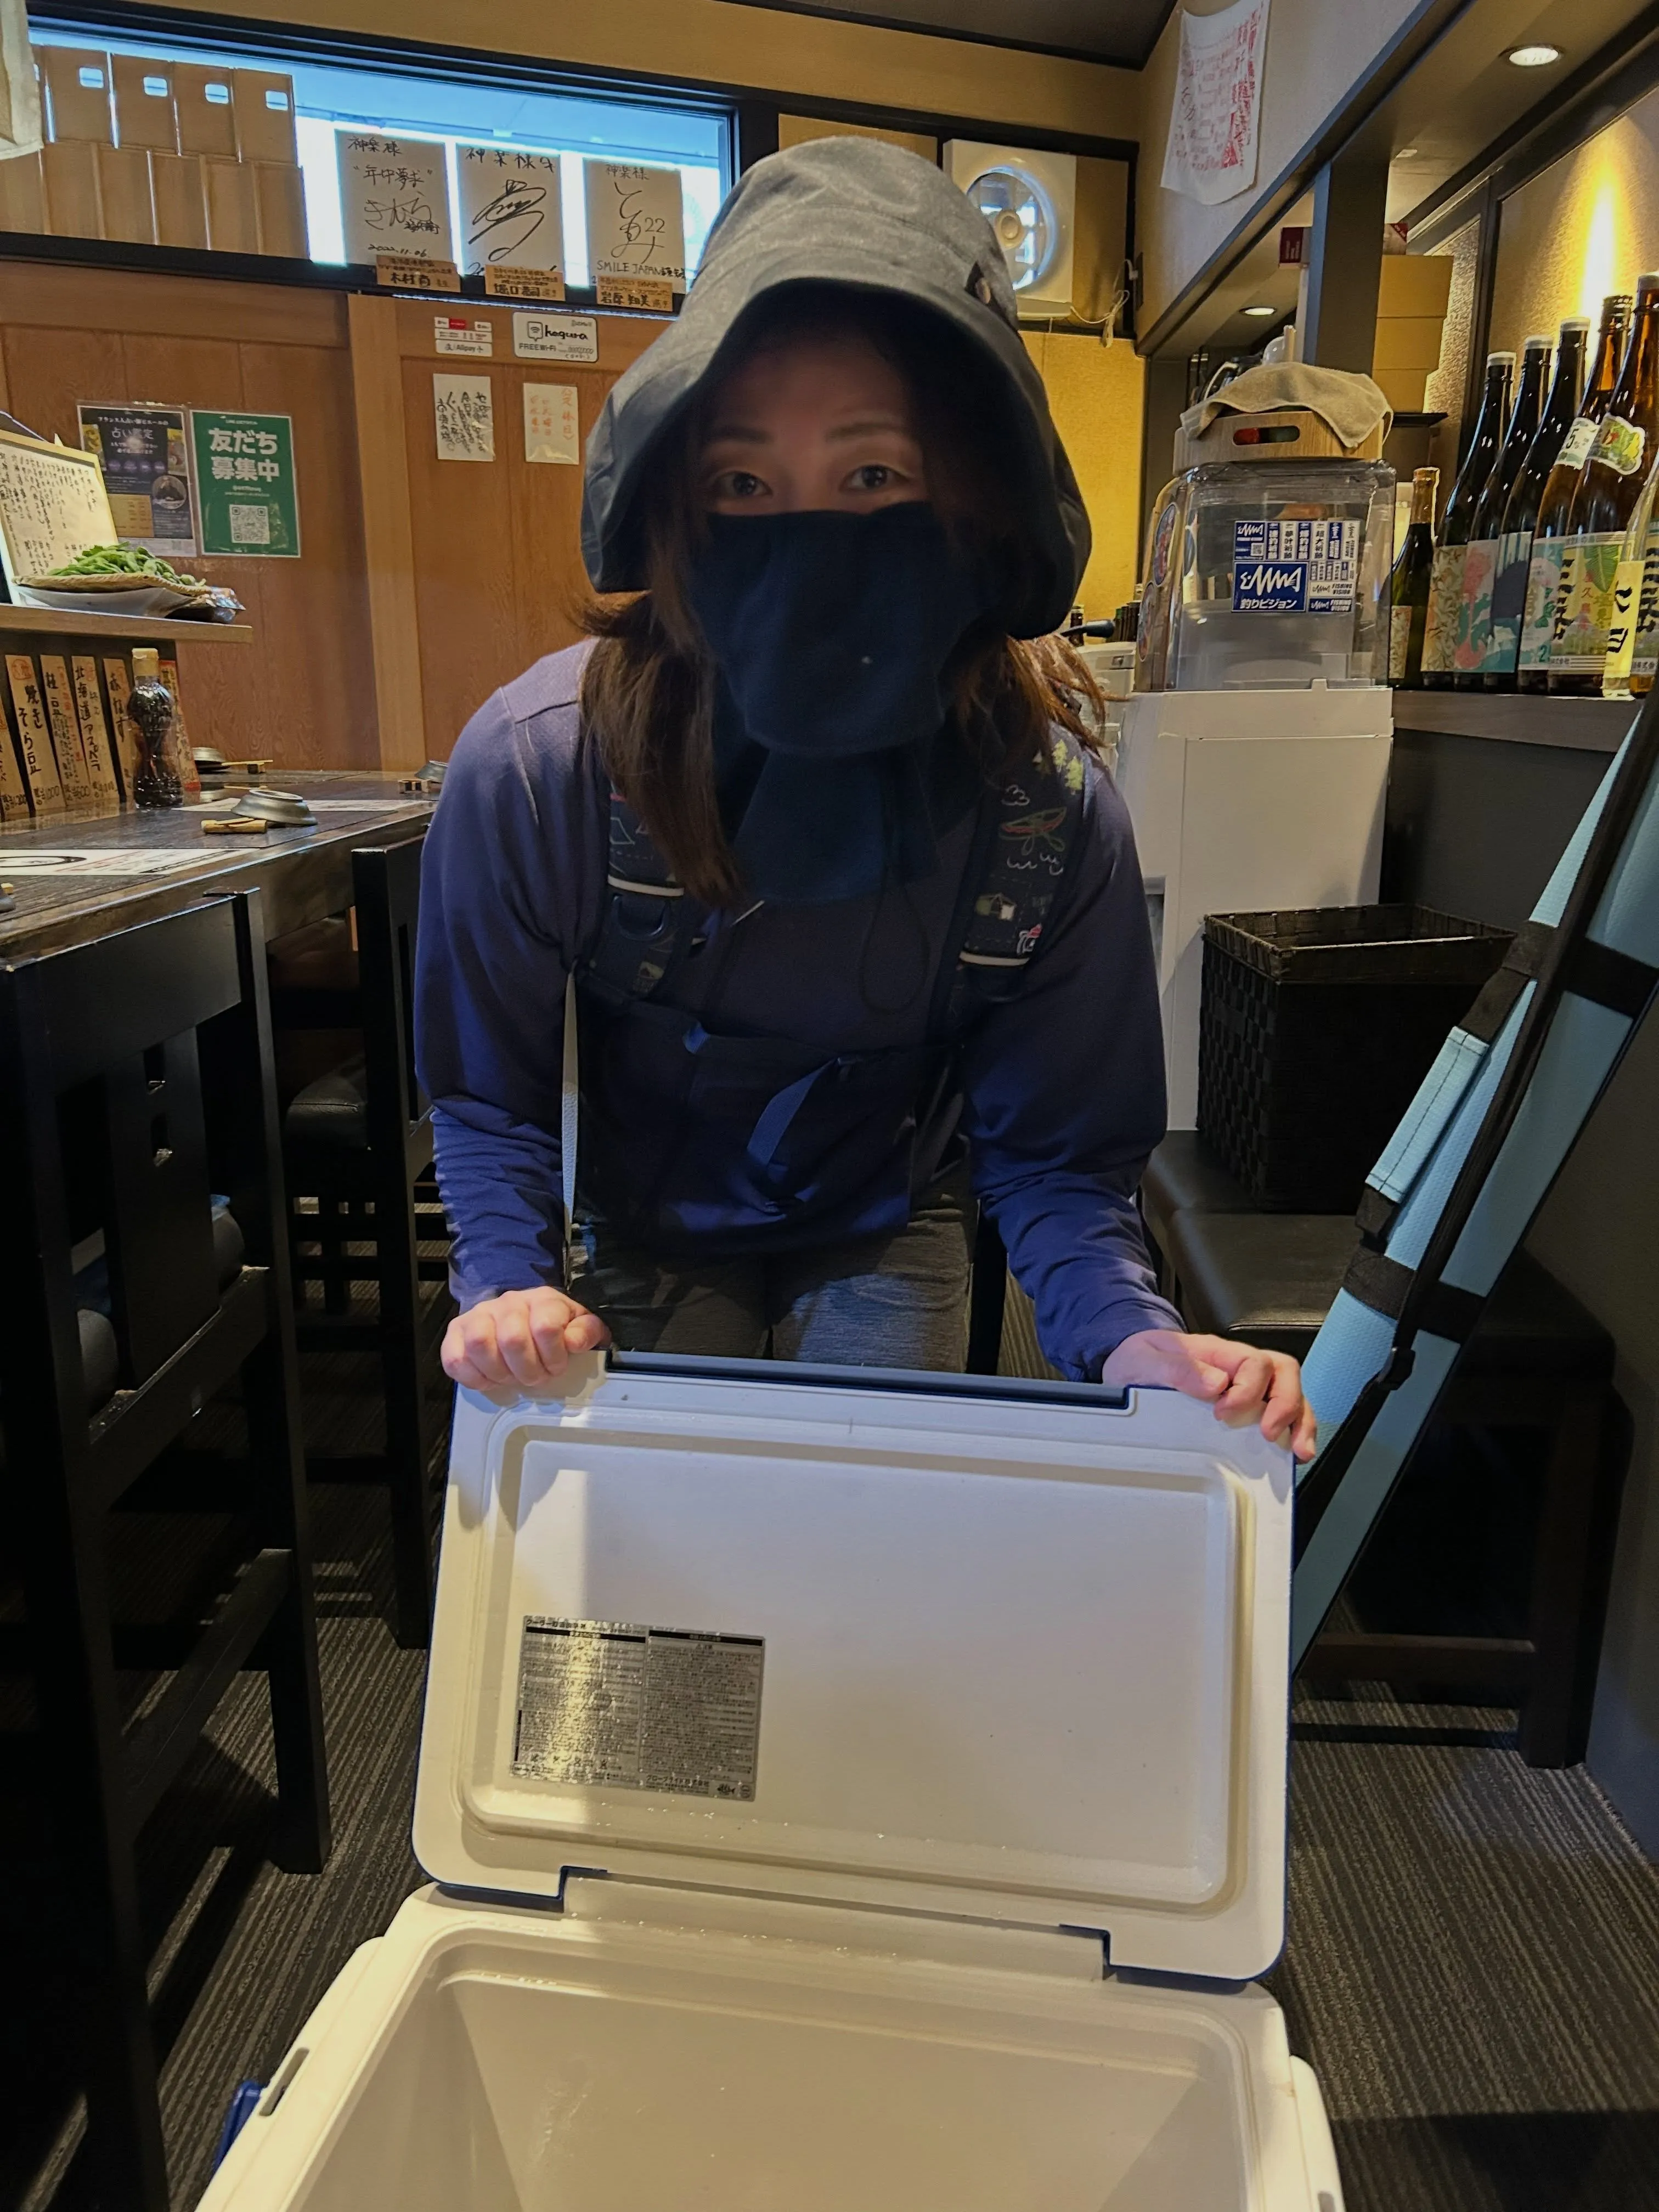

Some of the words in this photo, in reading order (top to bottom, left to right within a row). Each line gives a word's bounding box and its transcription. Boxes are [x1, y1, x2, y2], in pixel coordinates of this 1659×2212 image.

[606, 164, 650, 180] 神楽様
[597, 260, 629, 272] SMILE
[632, 263, 659, 275] JAPAN
[208, 428, 278, 455] 友だち
[211, 456, 280, 482] 募集中
[1240, 598, 1297, 609] 釣りビジョン
[19, 707, 41, 775] そら豆
